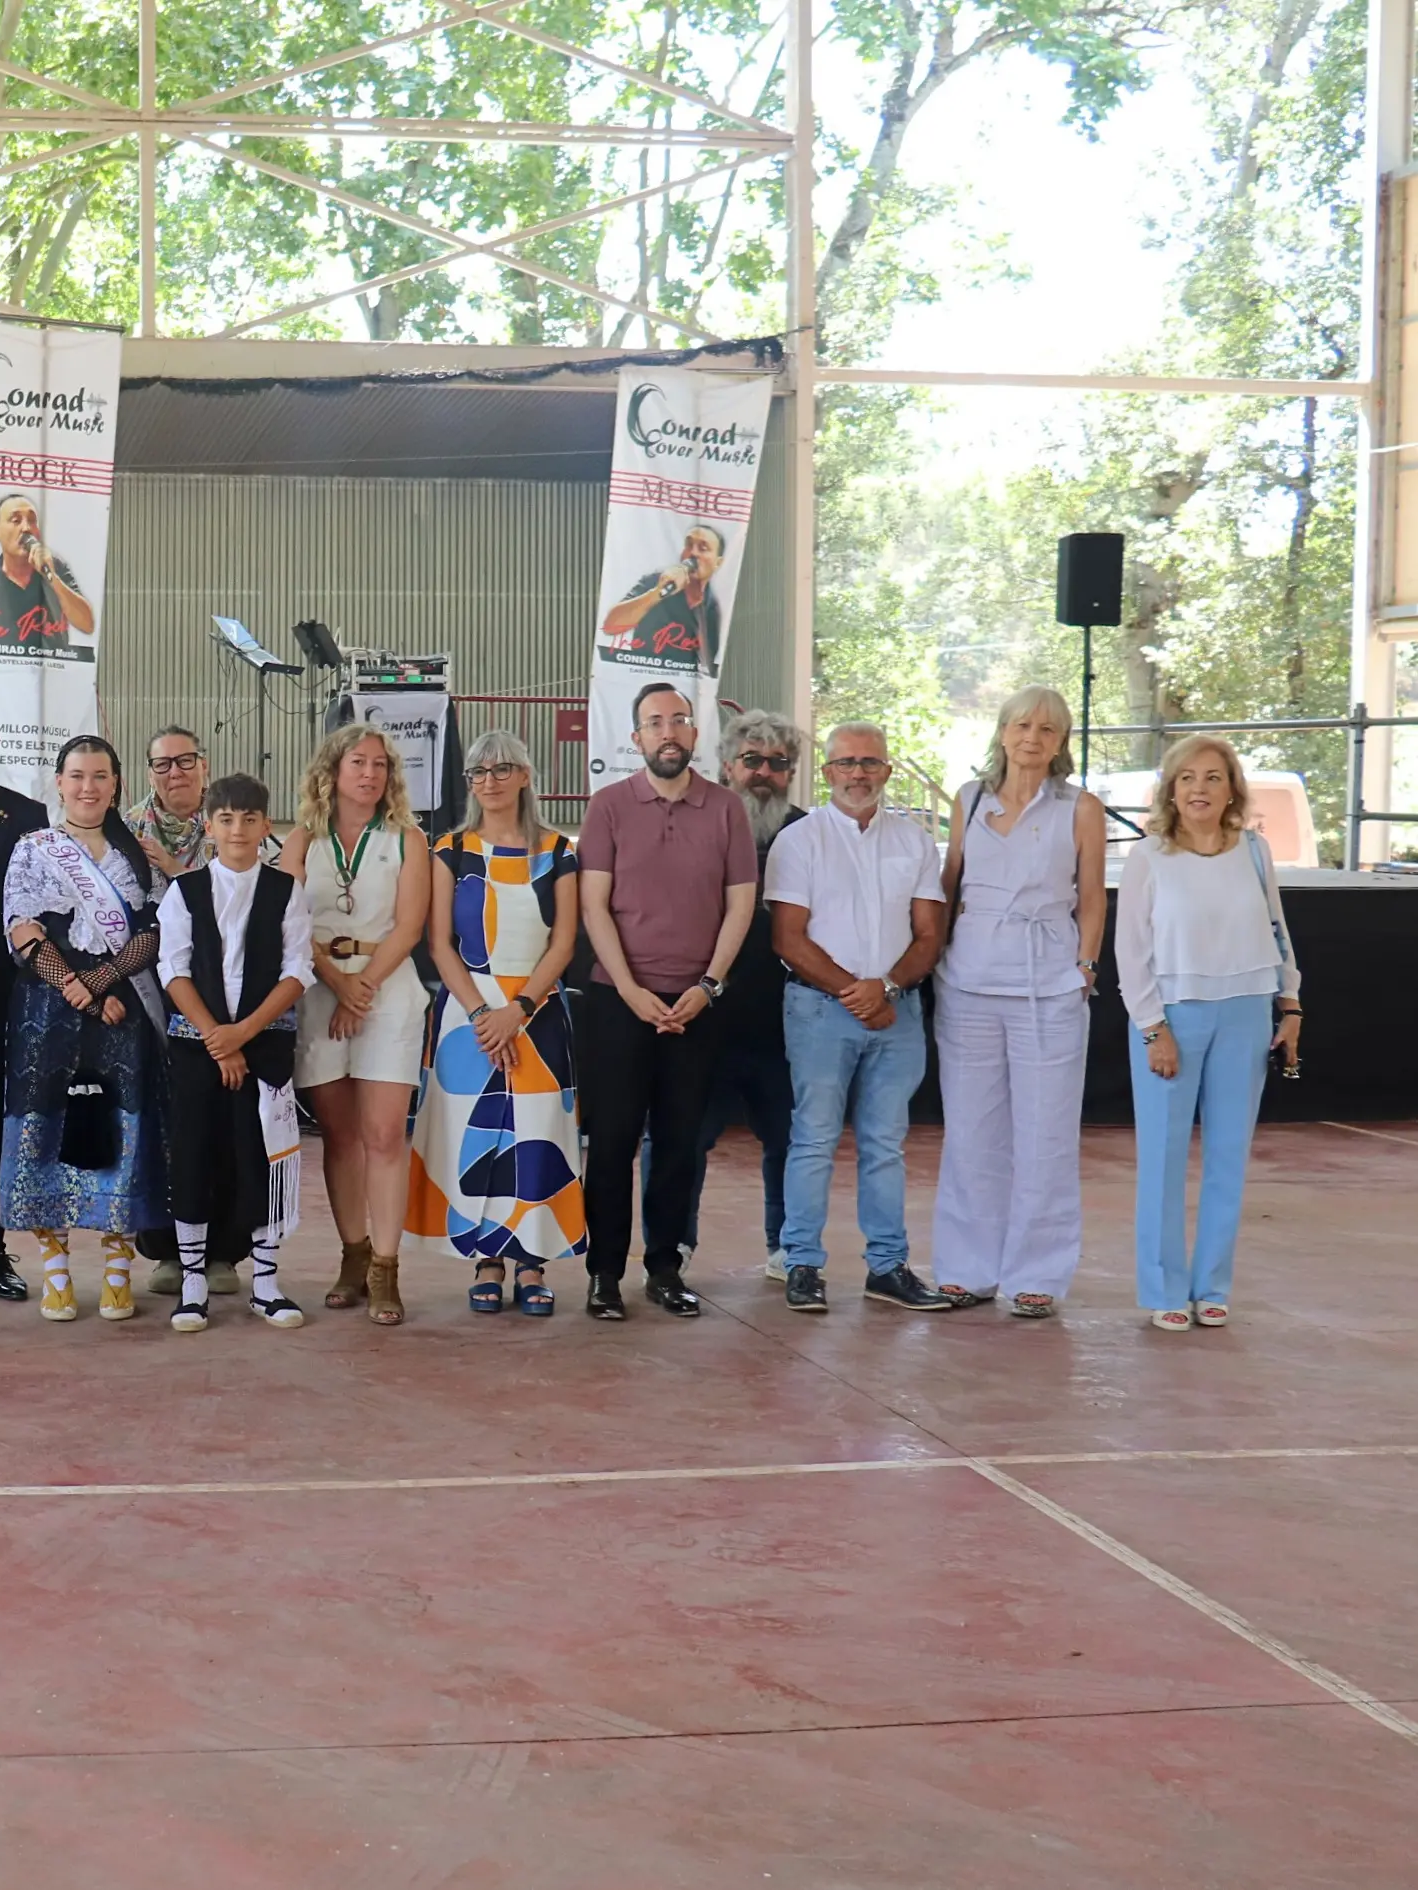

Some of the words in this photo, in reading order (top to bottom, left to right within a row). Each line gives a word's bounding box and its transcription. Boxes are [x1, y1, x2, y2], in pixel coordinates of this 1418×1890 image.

[49, 412, 105, 435] Music
[626, 383, 737, 446] Conrad
[699, 445, 757, 466] Music
[639, 478, 732, 516] MUSIC
[616, 653, 662, 667] CONRAD
[664, 659, 696, 670] Cover
[47, 846, 95, 901] Pubilla
